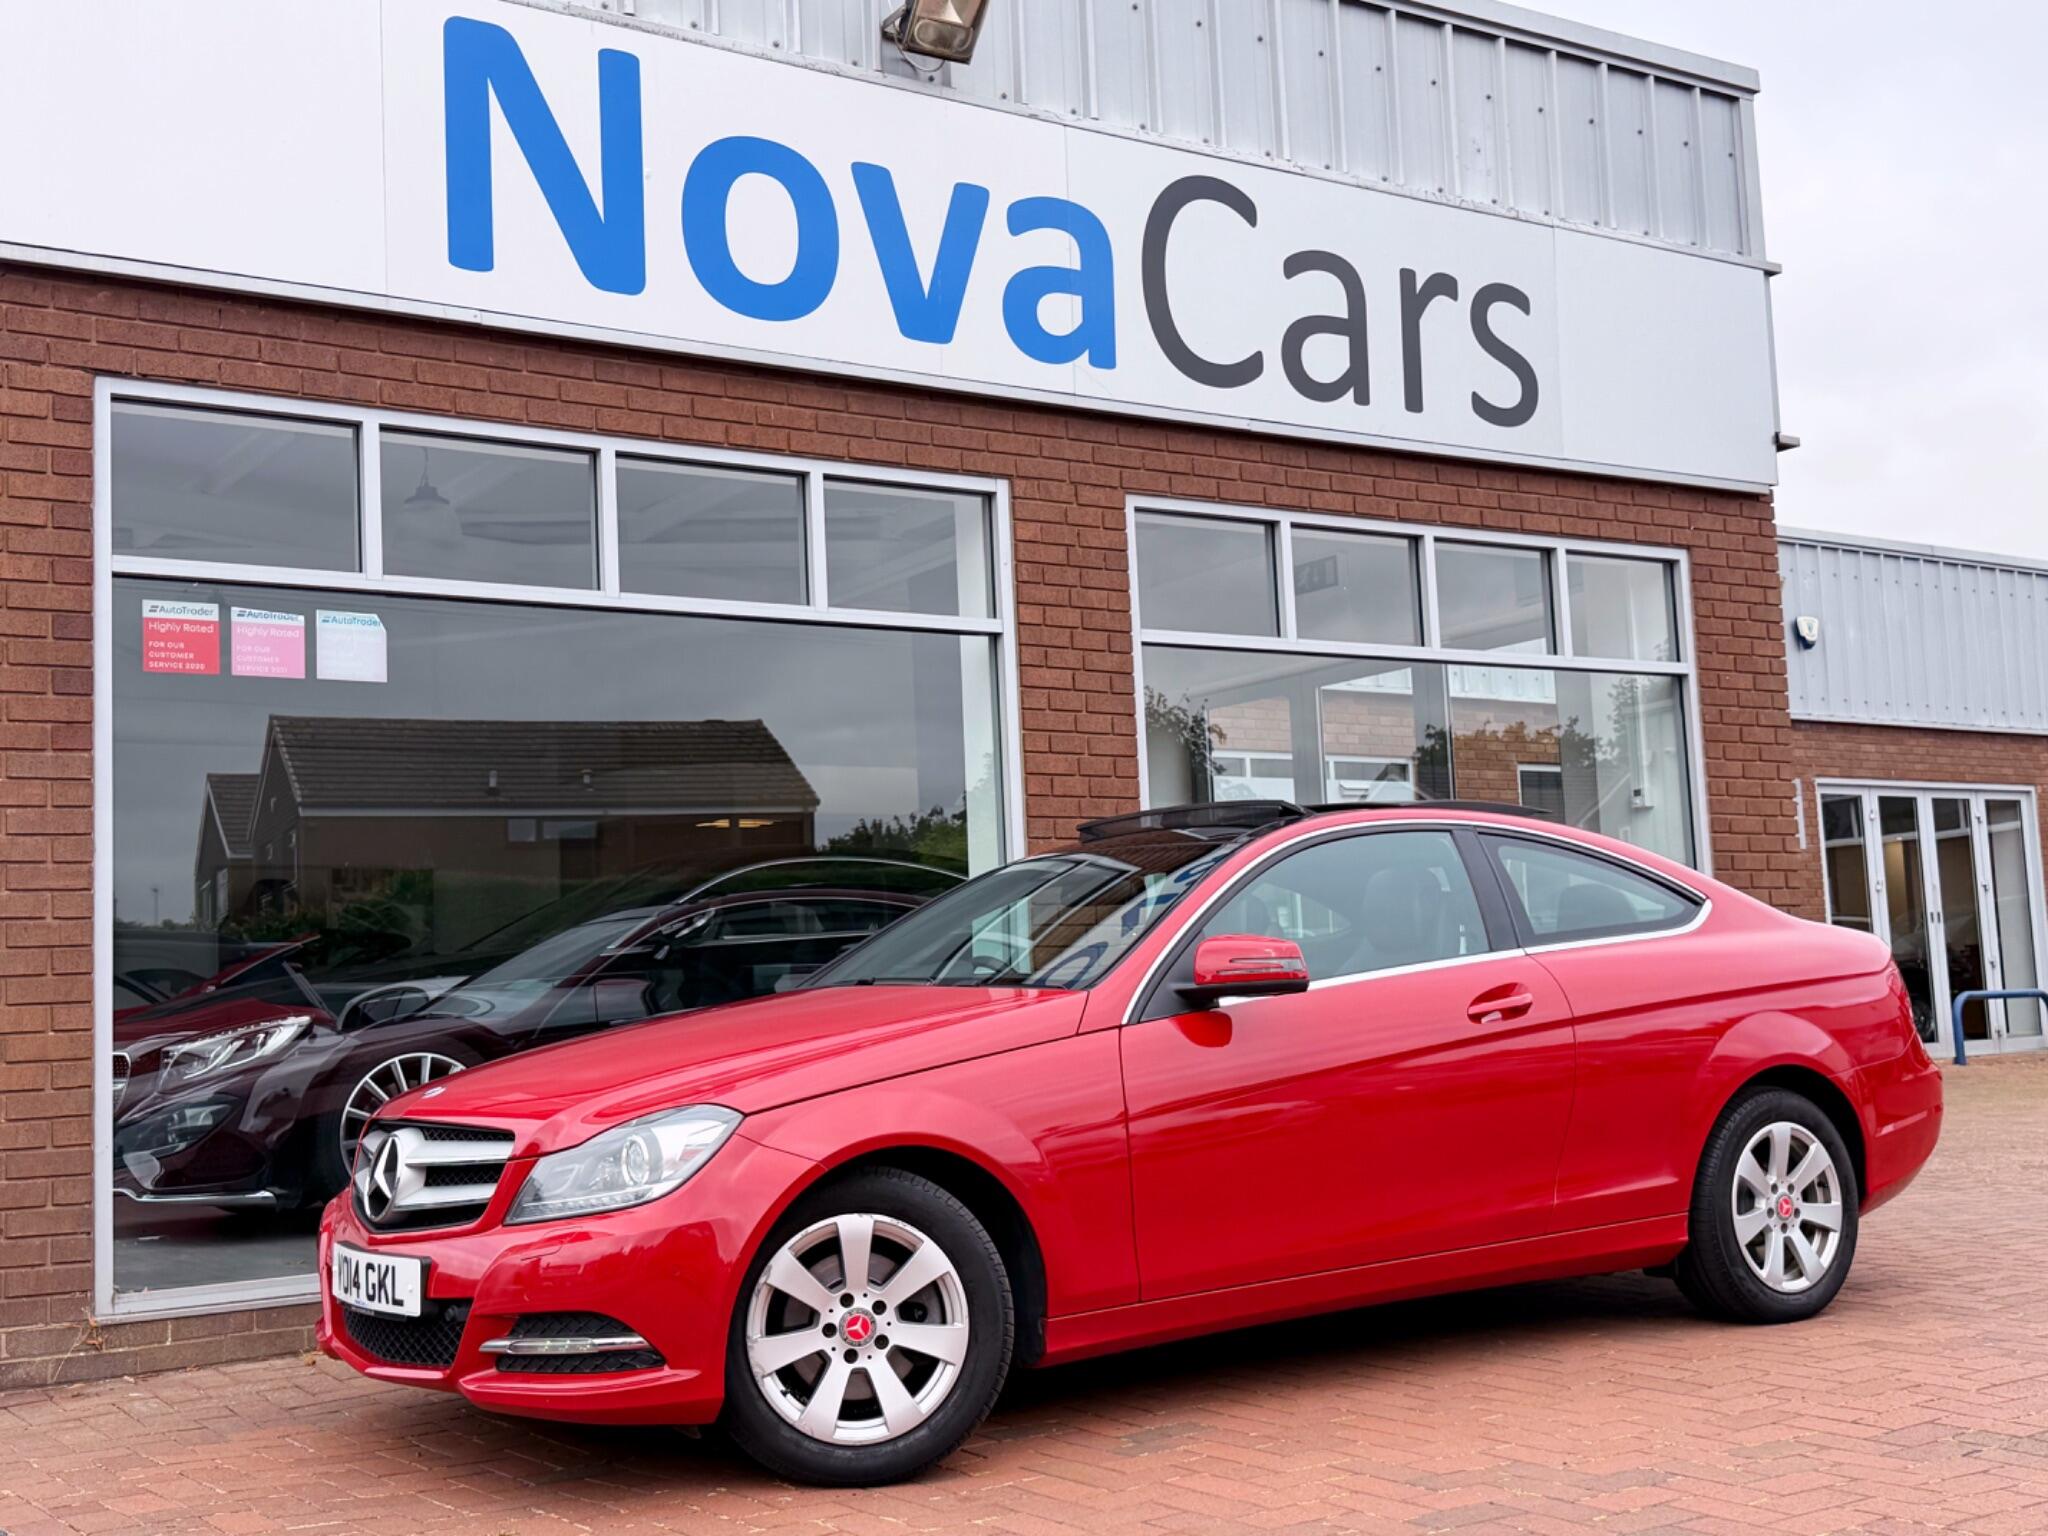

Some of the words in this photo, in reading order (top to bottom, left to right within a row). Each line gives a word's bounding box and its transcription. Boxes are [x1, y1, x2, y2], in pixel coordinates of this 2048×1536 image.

[444, 16, 1540, 427] NovaCars
[158, 605, 215, 617] AutoTrader
[148, 621, 181, 634] Highly
[183, 623, 215, 634] Rated
[148, 640, 166, 648] FOR
[167, 641, 185, 649] OUR
[148, 651, 195, 660] CUSTOMER
[148, 661, 184, 670] SERVICE
[365, 1262, 404, 1307] GKL
